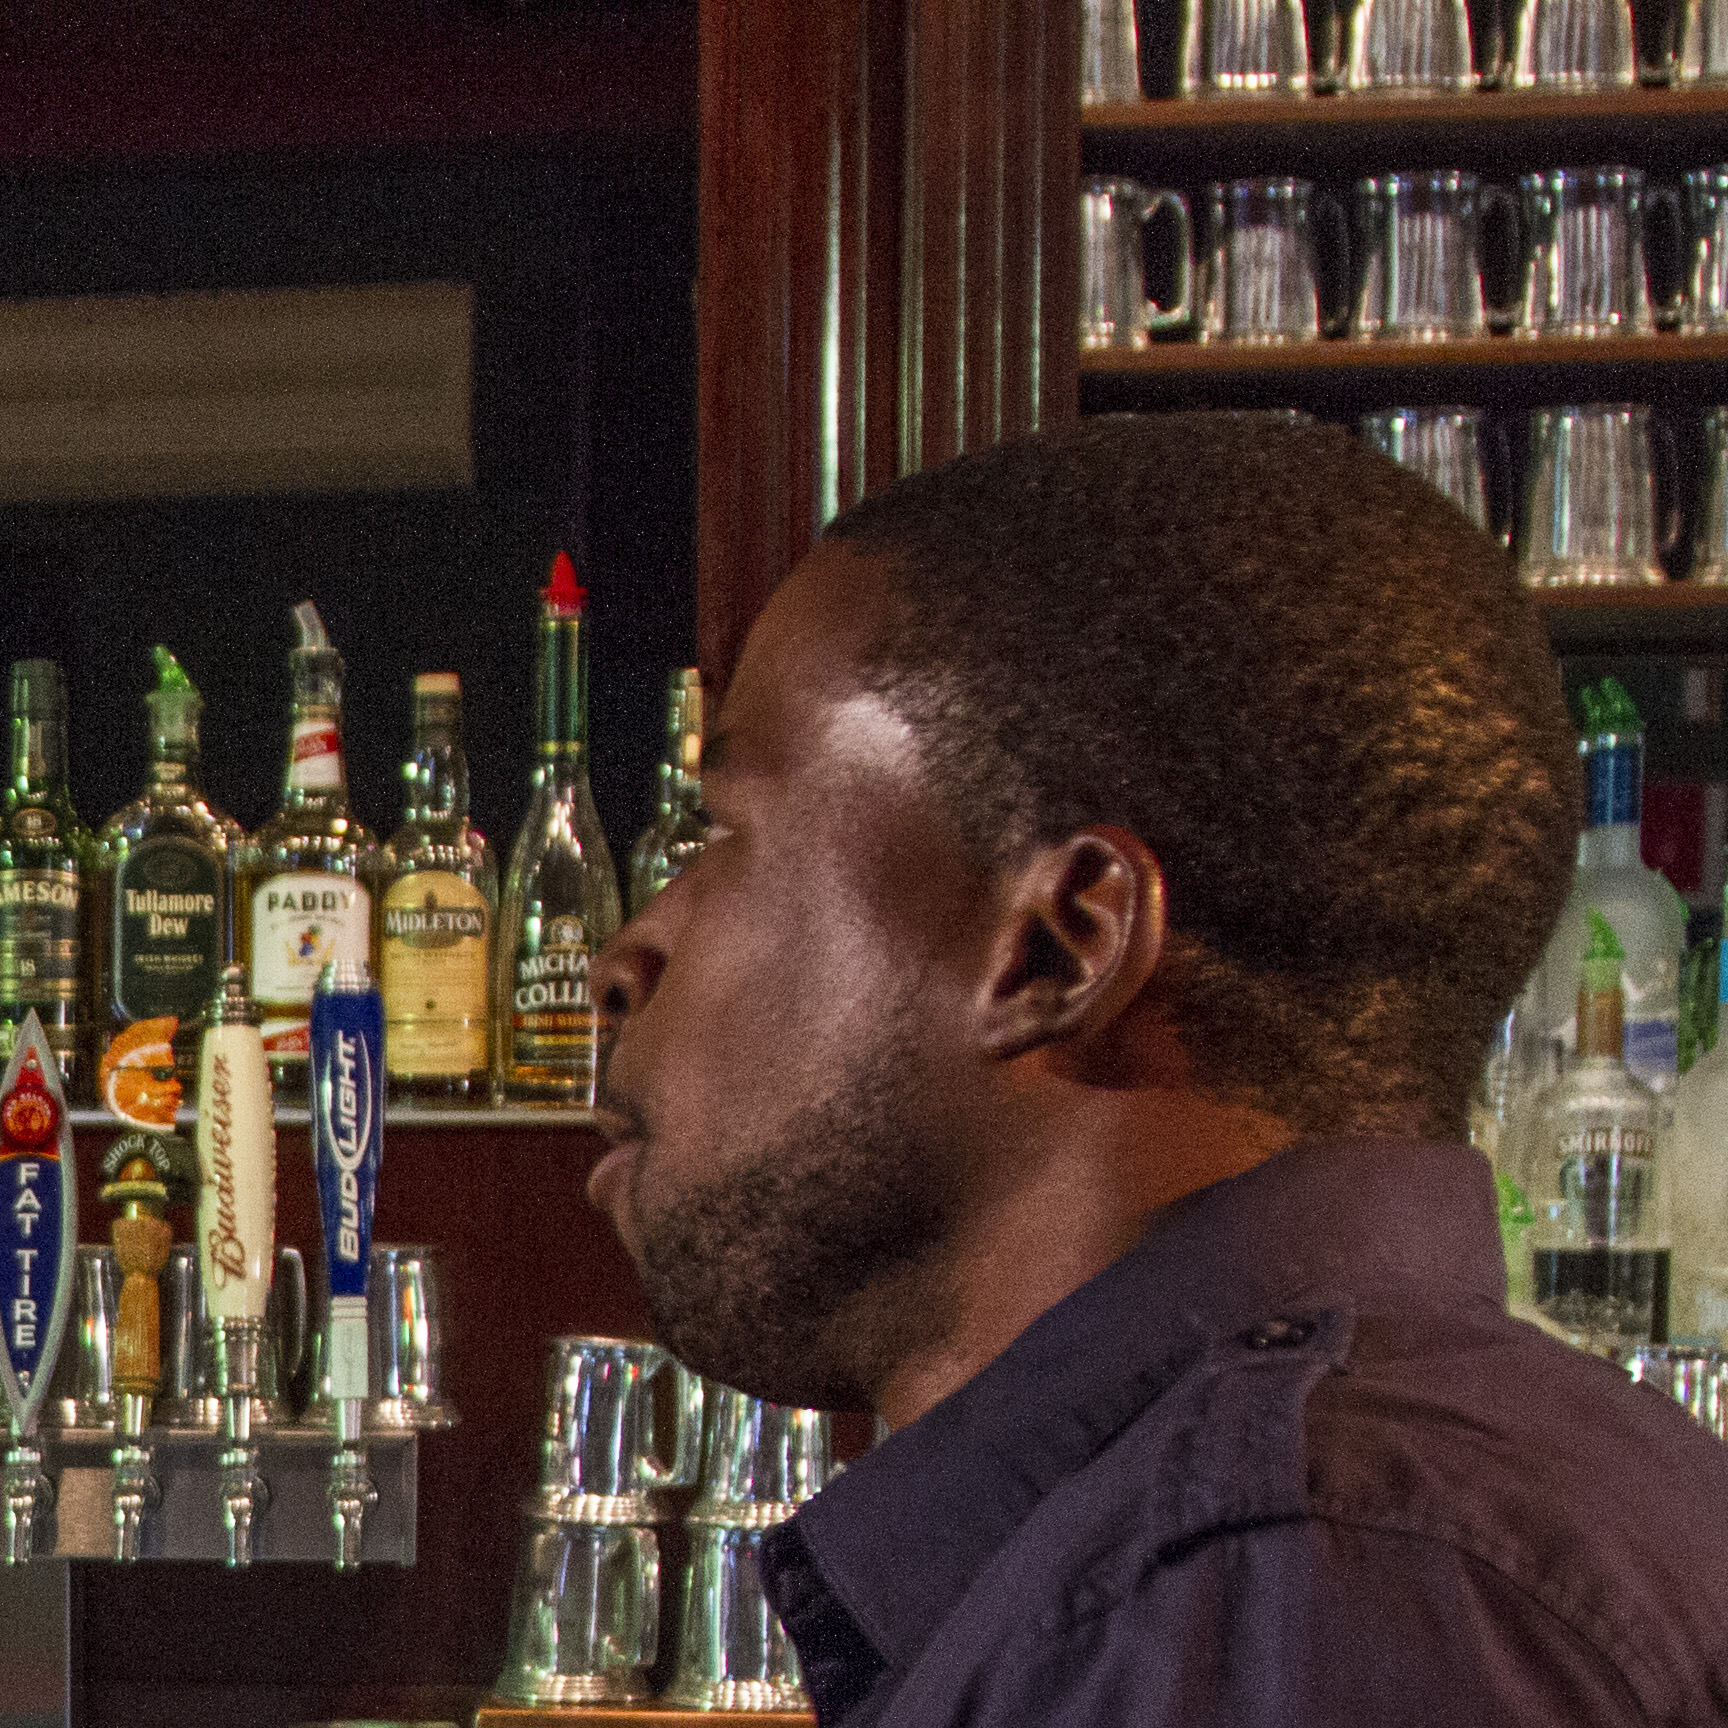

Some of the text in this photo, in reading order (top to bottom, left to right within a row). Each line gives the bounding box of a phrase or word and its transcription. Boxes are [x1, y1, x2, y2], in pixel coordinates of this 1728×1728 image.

[125, 888, 215, 914] Tullamore
[266, 889, 356, 912] PADDY
[148, 914, 189, 937] Dew
[384, 910, 483, 933] MIDLETON
[19, 959, 36, 977] 18
[518, 952, 590, 980] MICHA
[515, 981, 591, 1011] COLLI
[104, 1133, 171, 1173] SHOCK TOP
[212, 1051, 247, 1289] Budweiser
[14, 1163, 42, 1236] FAT
[337, 1169, 360, 1263] BUD
[14, 1249, 39, 1346] TIRE
